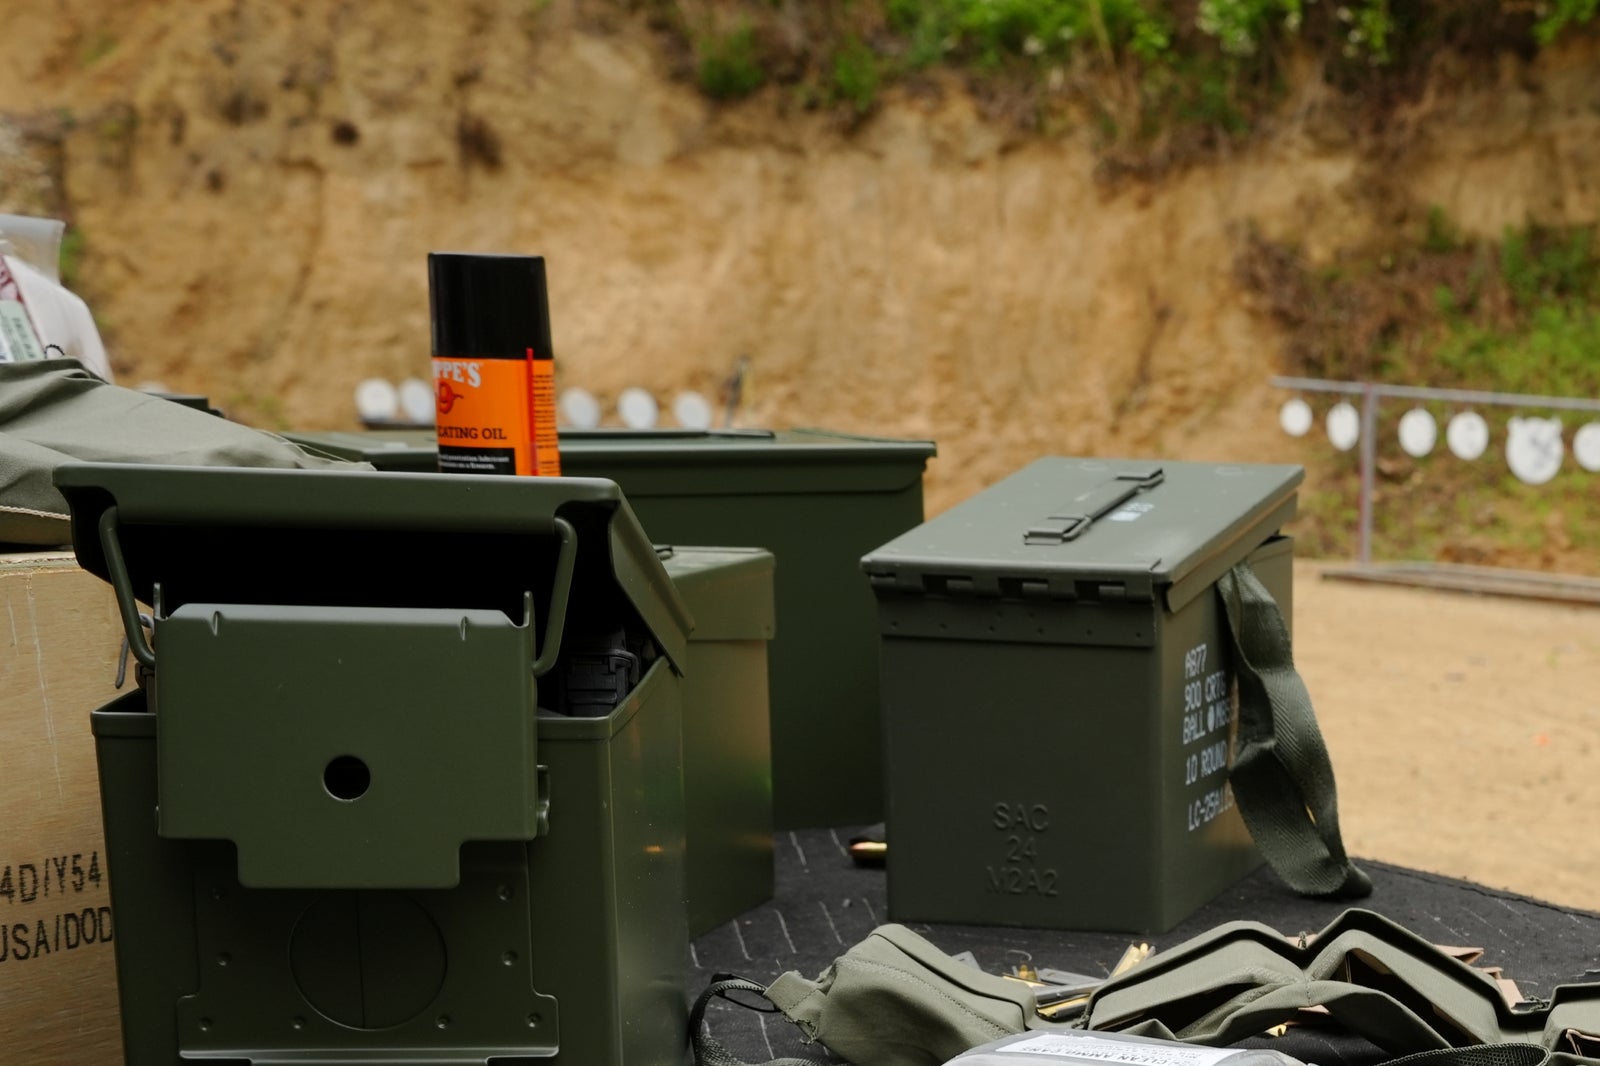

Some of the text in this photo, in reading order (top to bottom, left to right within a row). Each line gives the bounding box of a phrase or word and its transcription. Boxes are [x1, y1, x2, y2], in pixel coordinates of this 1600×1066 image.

[432, 361, 482, 388] PPE'S
[481, 428, 508, 440] OIL
[1184, 681, 1202, 712] 900
[1183, 711, 1207, 744] BALL
[1185, 740, 1228, 786] 10 ROUND
[992, 801, 1049, 832] SAC
[1007, 835, 1038, 863] 24
[985, 866, 1059, 896] M2A2
